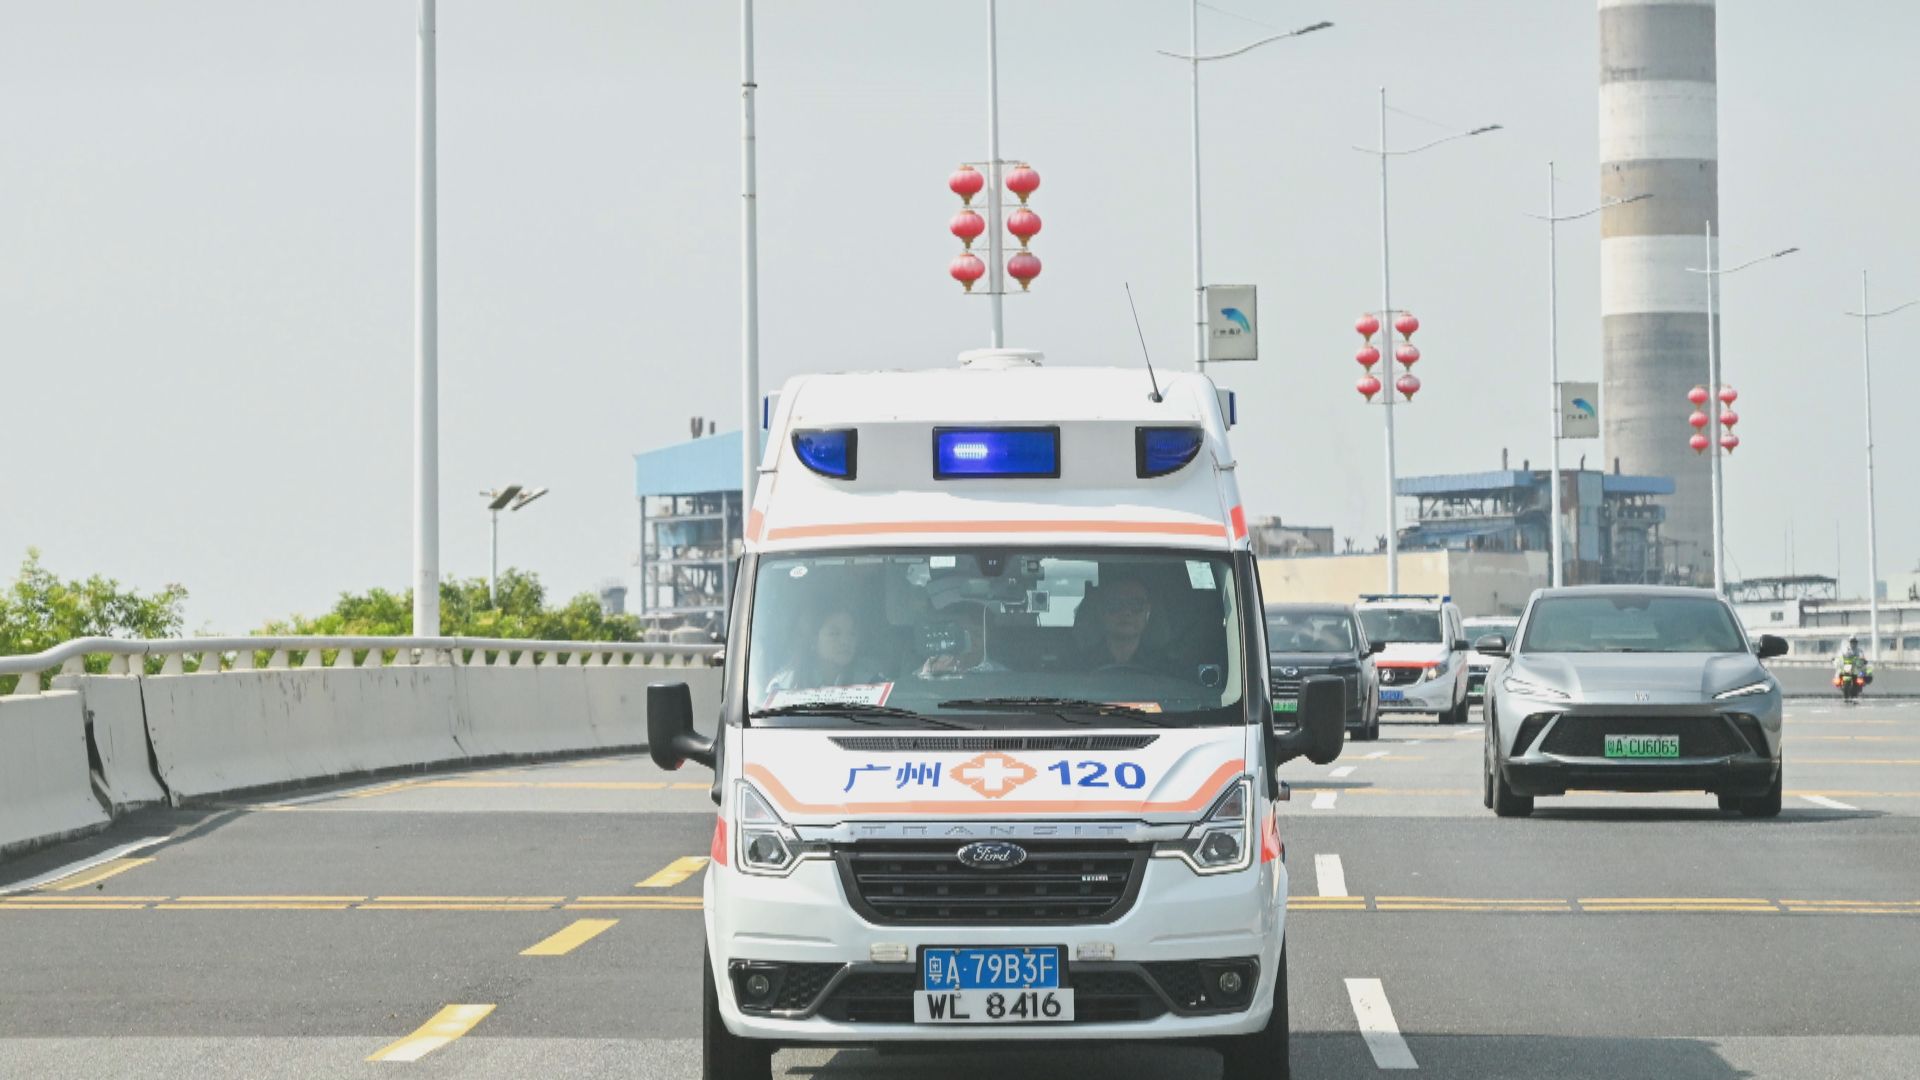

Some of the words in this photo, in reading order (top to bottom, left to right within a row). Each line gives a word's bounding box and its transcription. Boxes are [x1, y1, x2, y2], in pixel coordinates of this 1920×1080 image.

[843, 761, 942, 793] 广州
[1047, 760, 1146, 790] 120
[861, 824, 1124, 836] TRANSIT
[973, 846, 1011, 861] Ford
[926, 993, 970, 1020] WL
[986, 991, 1062, 1019] 8416
